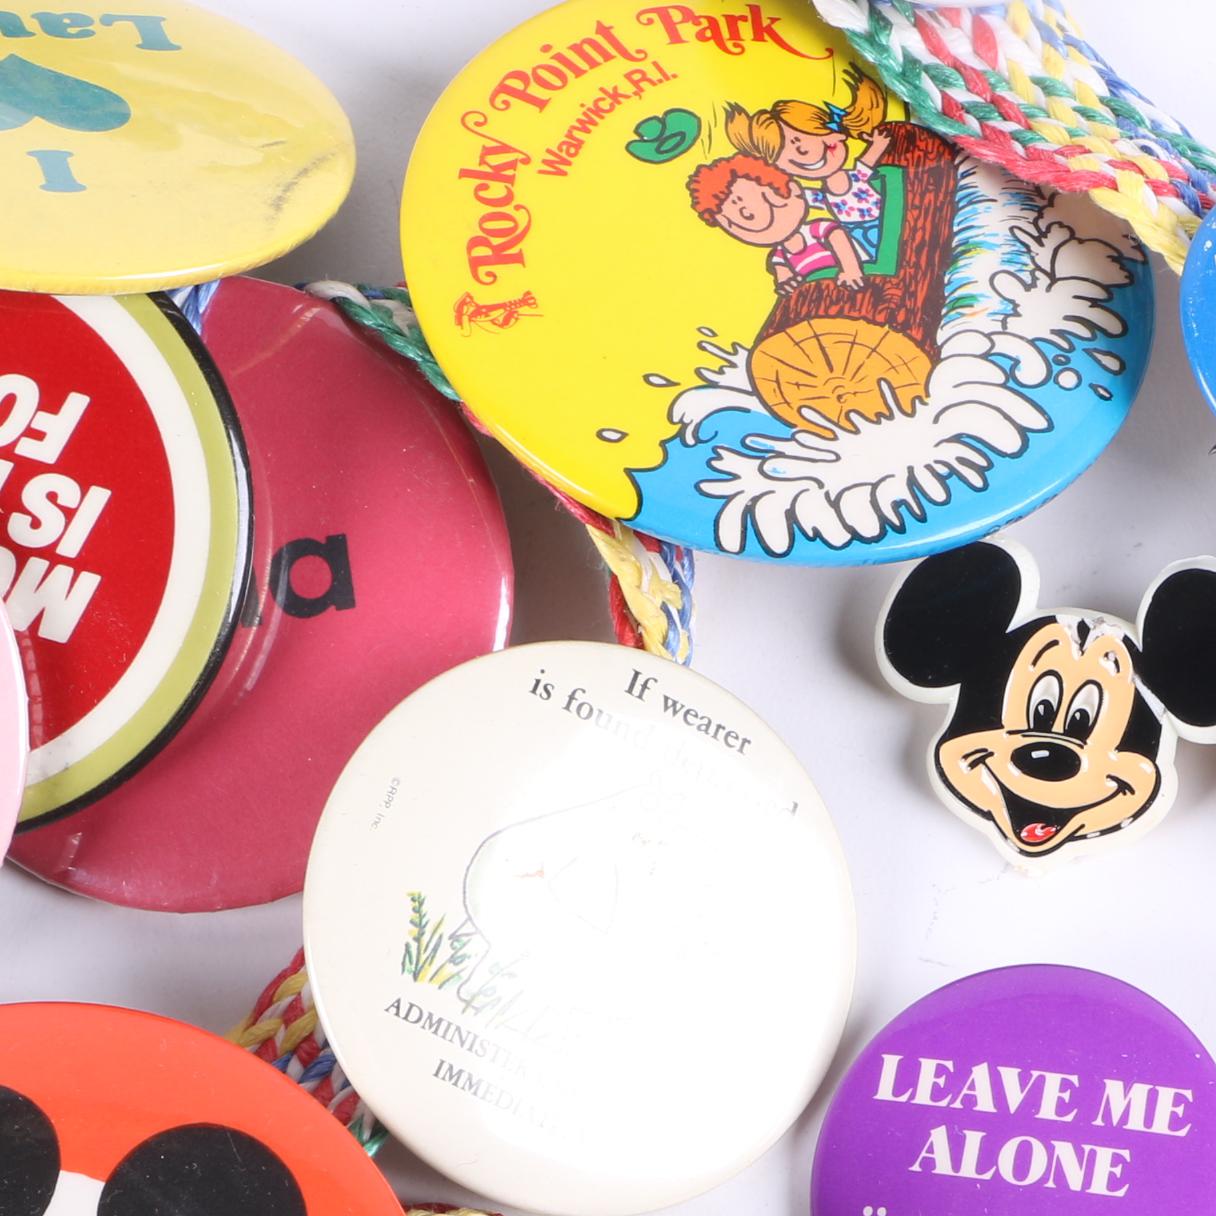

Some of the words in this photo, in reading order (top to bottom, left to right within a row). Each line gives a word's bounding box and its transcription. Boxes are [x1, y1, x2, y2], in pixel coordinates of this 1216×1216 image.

[489, 20, 648, 113] Point
[636, 4, 834, 60] Park
[26, 150, 87, 193] I
[458, 110, 532, 286] Rocky
[529, 668, 555, 701] is
[624, 668, 658, 701] If
[662, 694, 752, 755] wearer
[873, 1054, 1079, 1122] LEAVE
[1092, 1078, 1193, 1137] ME
[909, 1125, 1131, 1198] ALONE
